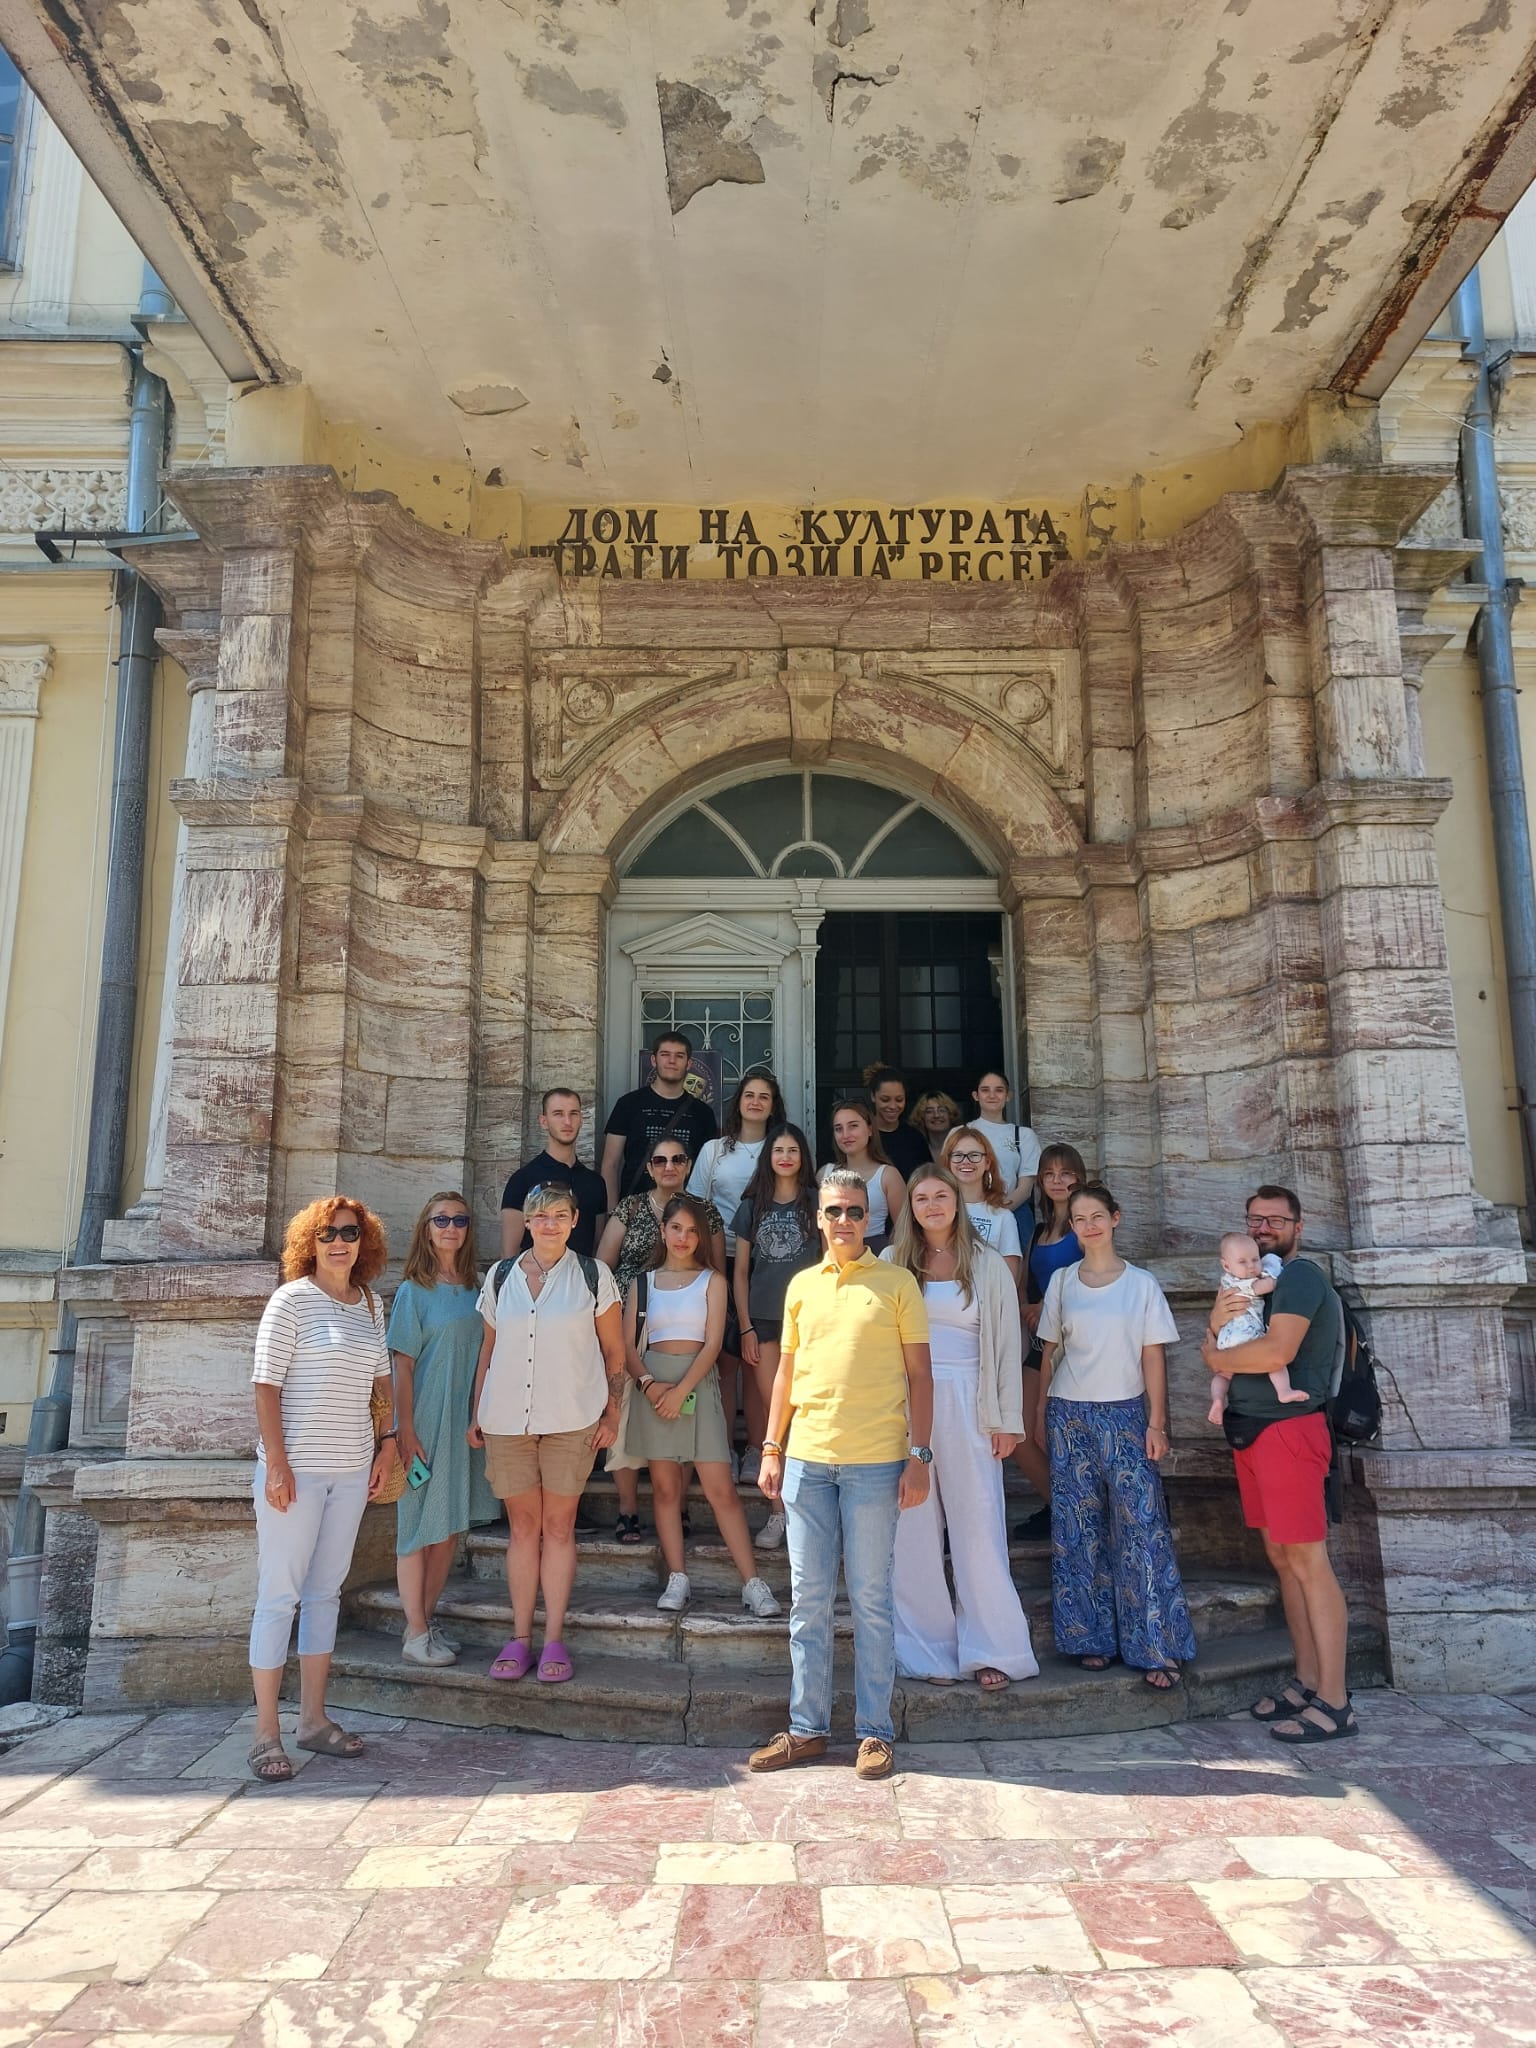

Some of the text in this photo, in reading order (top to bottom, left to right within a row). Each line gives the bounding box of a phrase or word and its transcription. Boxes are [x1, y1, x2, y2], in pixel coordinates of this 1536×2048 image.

[557, 508, 1061, 545] ДОМ НА КУЛТУРАТА
